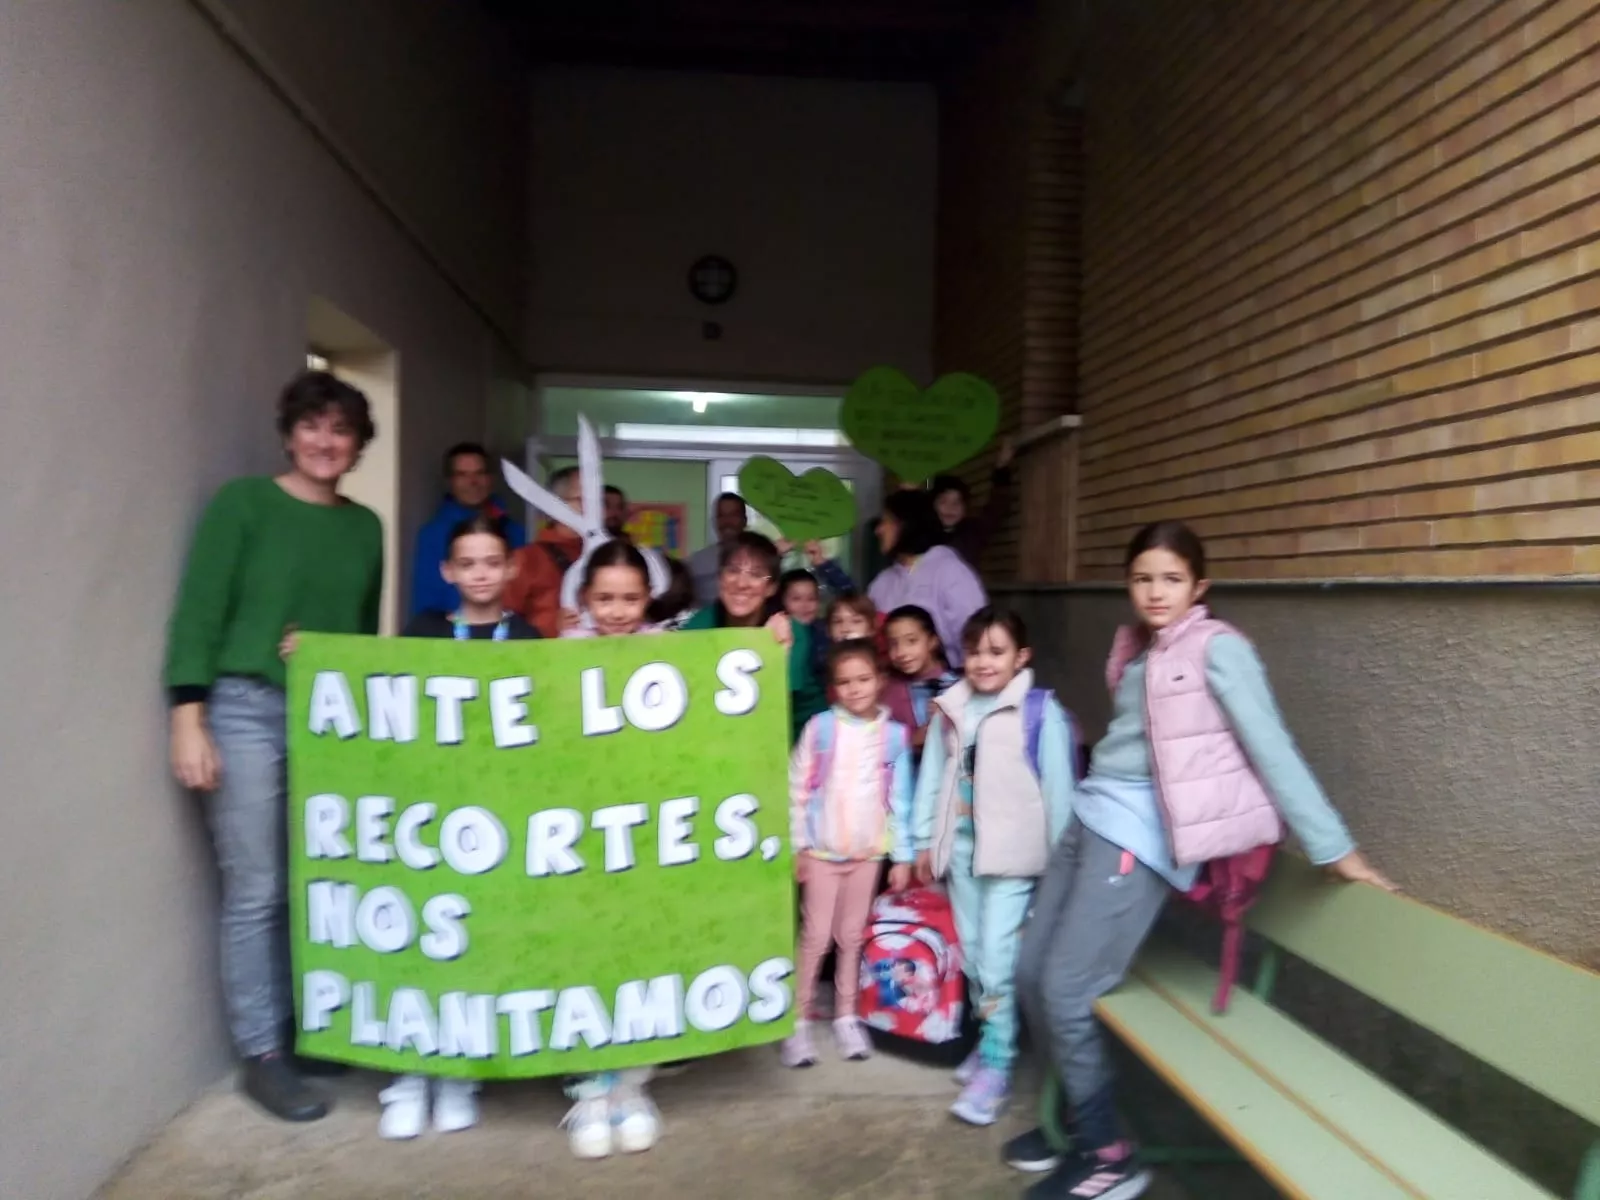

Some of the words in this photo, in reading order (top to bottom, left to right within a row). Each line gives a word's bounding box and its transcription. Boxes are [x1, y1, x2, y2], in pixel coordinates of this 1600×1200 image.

[308, 670, 539, 748] ANTE
[580, 648, 763, 738] LOS
[304, 793, 782, 877] RECORTES,
[306, 877, 472, 960] NOS
[303, 957, 796, 1059] PLANTAMOS
